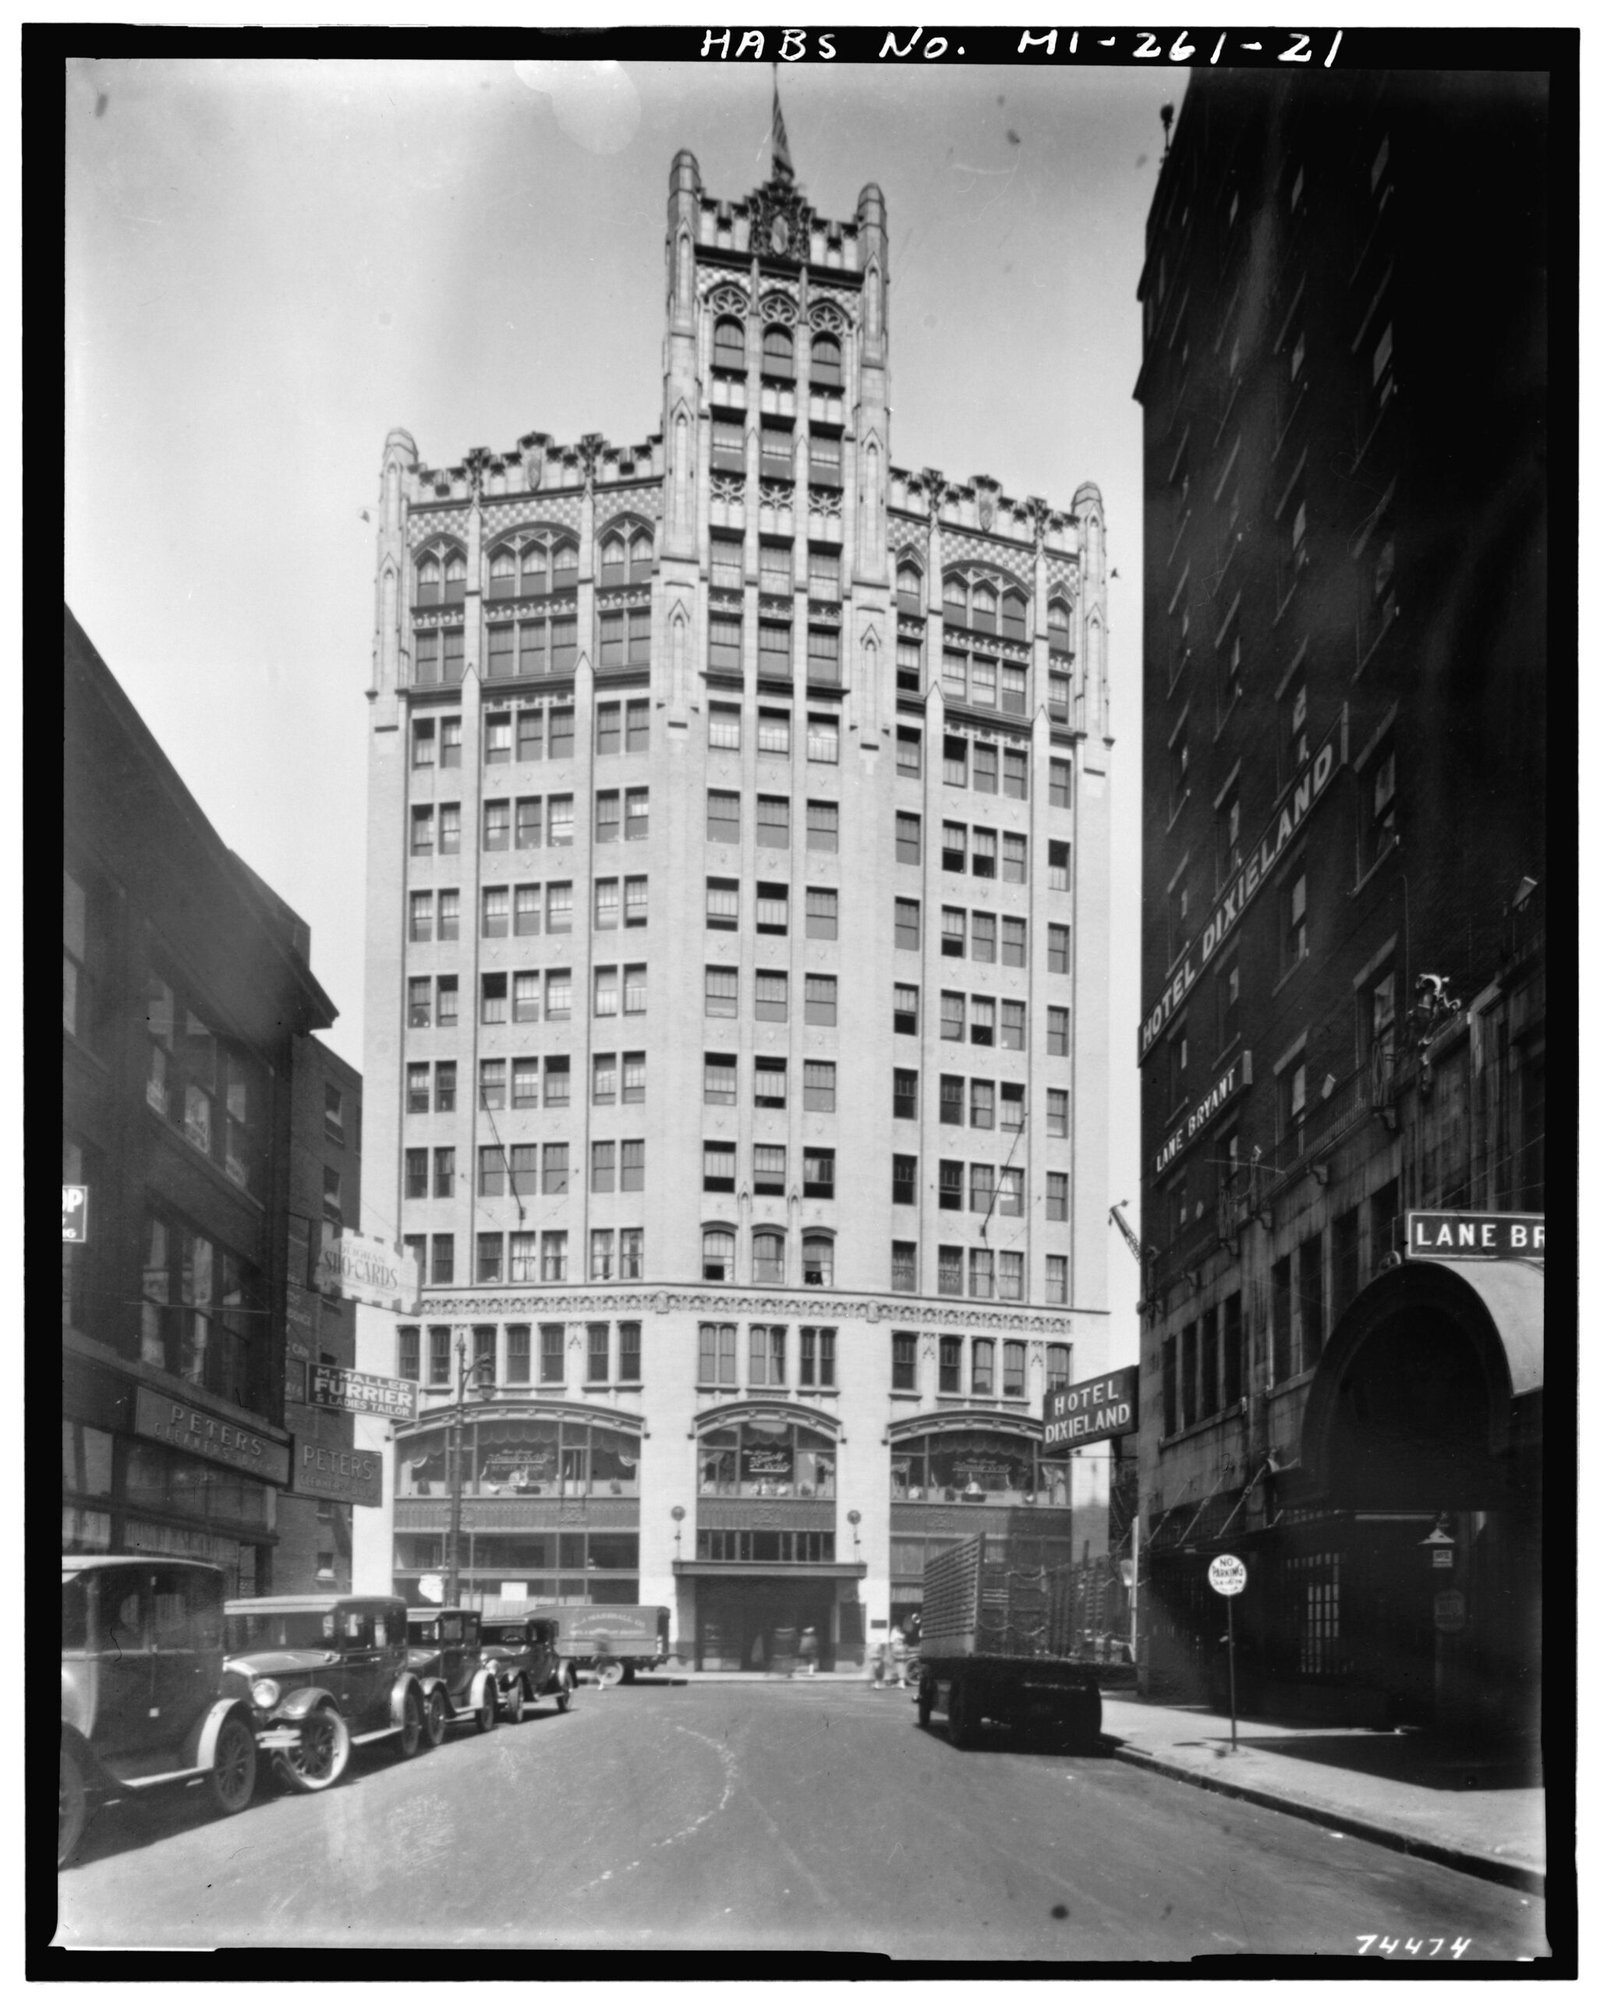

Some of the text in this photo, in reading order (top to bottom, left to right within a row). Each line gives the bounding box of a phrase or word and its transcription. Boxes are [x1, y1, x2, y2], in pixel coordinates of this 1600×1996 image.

[1142, 744, 1332, 1050] HOTEL DIXIELAND
[1156, 1068, 1235, 1173] LANE BRYANT
[1416, 1222, 1497, 1247] LANE
[313, 1377, 414, 1408] FURRIER
[328, 1394, 369, 1411] LADIES
[370, 1401, 411, 1417] TAILOR
[1054, 1379, 1120, 1417] HOTEL
[1045, 1403, 1131, 1444] DIXIELAND
[1212, 1563, 1243, 1578] PARKING
[1219, 1558, 1233, 1567] NO
